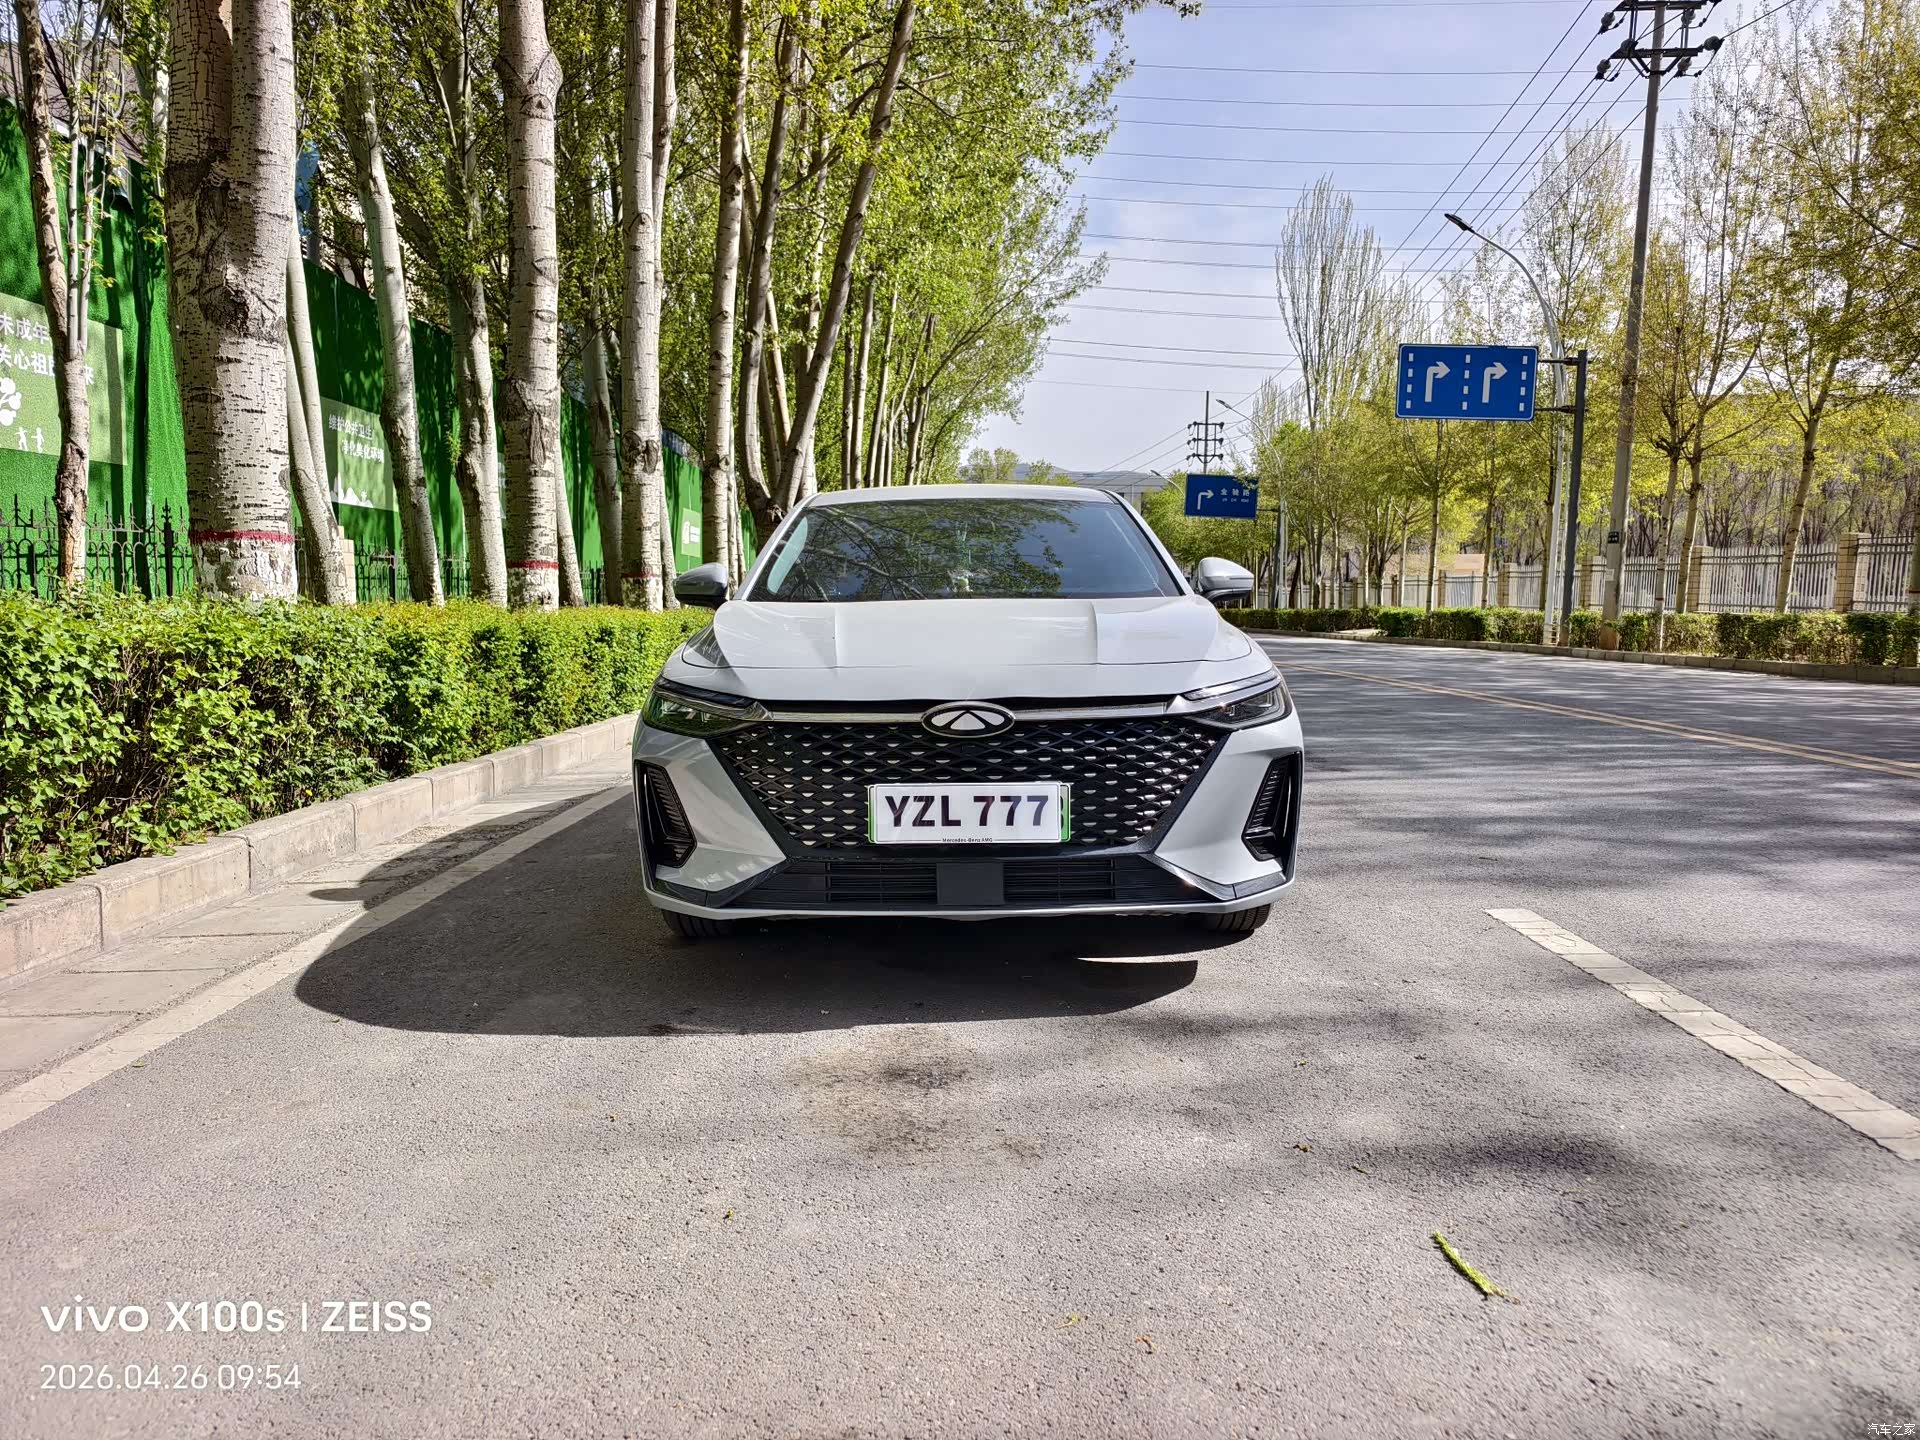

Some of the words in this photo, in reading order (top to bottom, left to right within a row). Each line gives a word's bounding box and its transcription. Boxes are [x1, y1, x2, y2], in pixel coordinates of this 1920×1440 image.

[0, 312, 52, 346] 未成年
[0, 343, 94, 385] 关心祖来
[328, 413, 373, 441] 维护公共卫生
[885, 795, 961, 827] YZL
[973, 795, 1049, 827] 777
